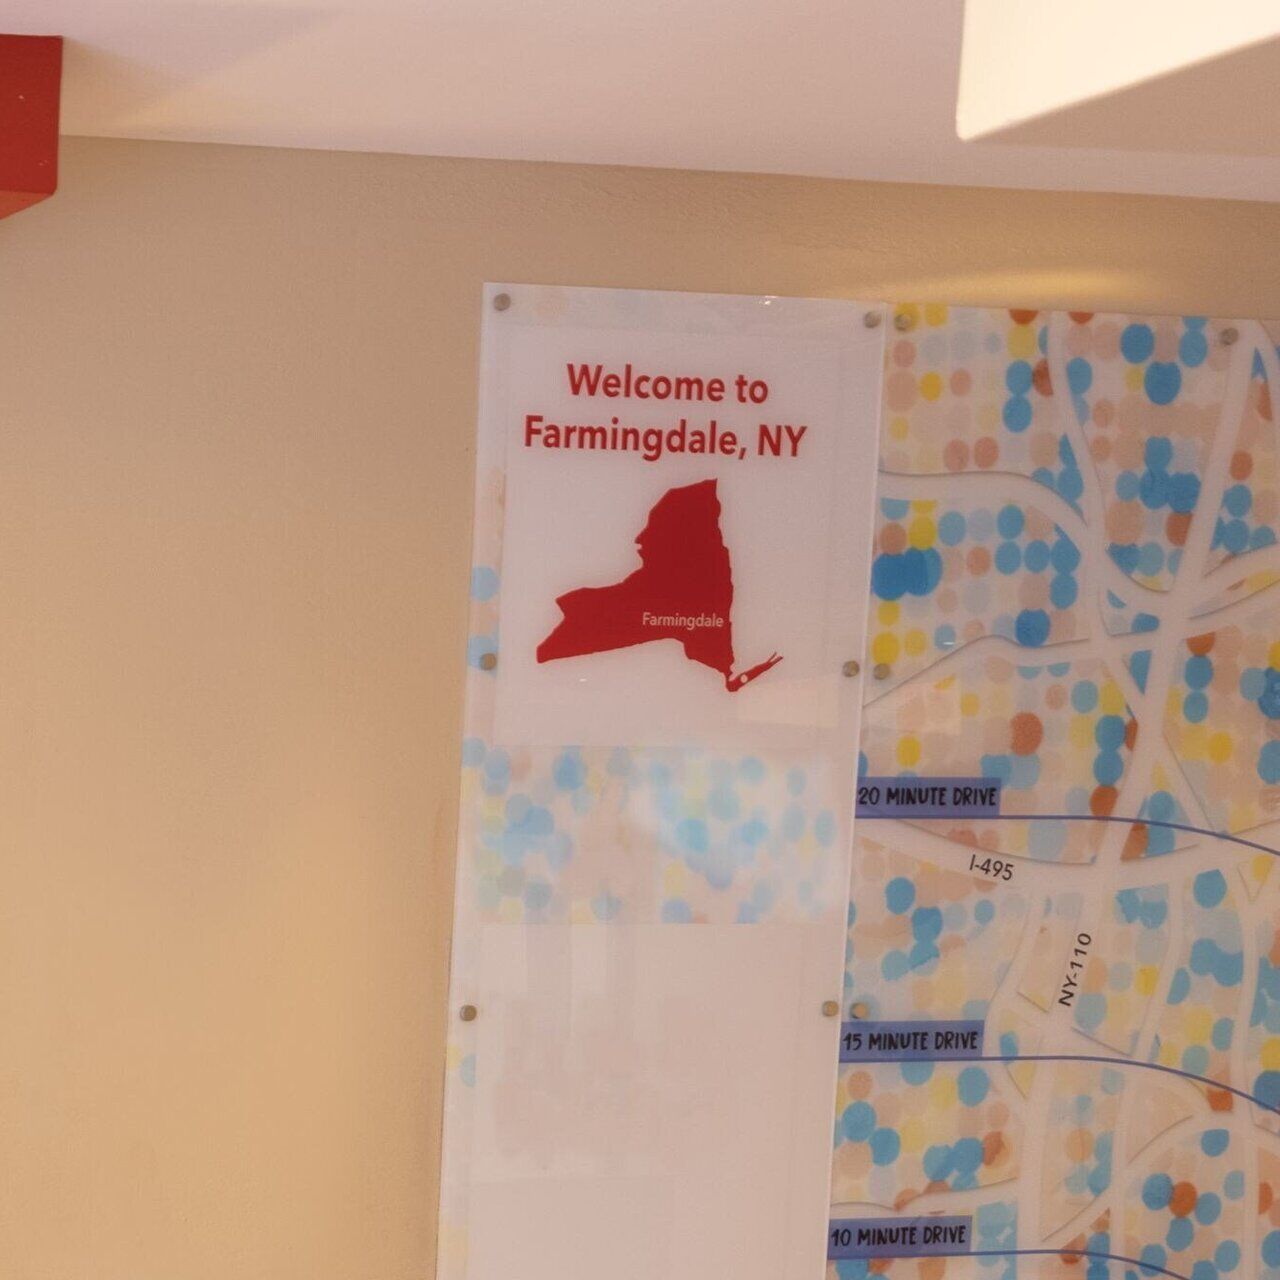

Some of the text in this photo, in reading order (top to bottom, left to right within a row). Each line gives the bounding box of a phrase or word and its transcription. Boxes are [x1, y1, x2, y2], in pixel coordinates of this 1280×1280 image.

[566, 363, 769, 405] Welcome to
[524, 414, 807, 462] Farmingdale, NY
[641, 611, 724, 630] Farmingdale
[858, 787, 997, 806] 20 MINUTE DRIVE
[969, 854, 1015, 881] I-495
[1059, 933, 1092, 1007] NY-110
[843, 1031, 978, 1051] 15 MINUTE DRIVE
[831, 1224, 966, 1246] 10 MINUTE DRIVE
